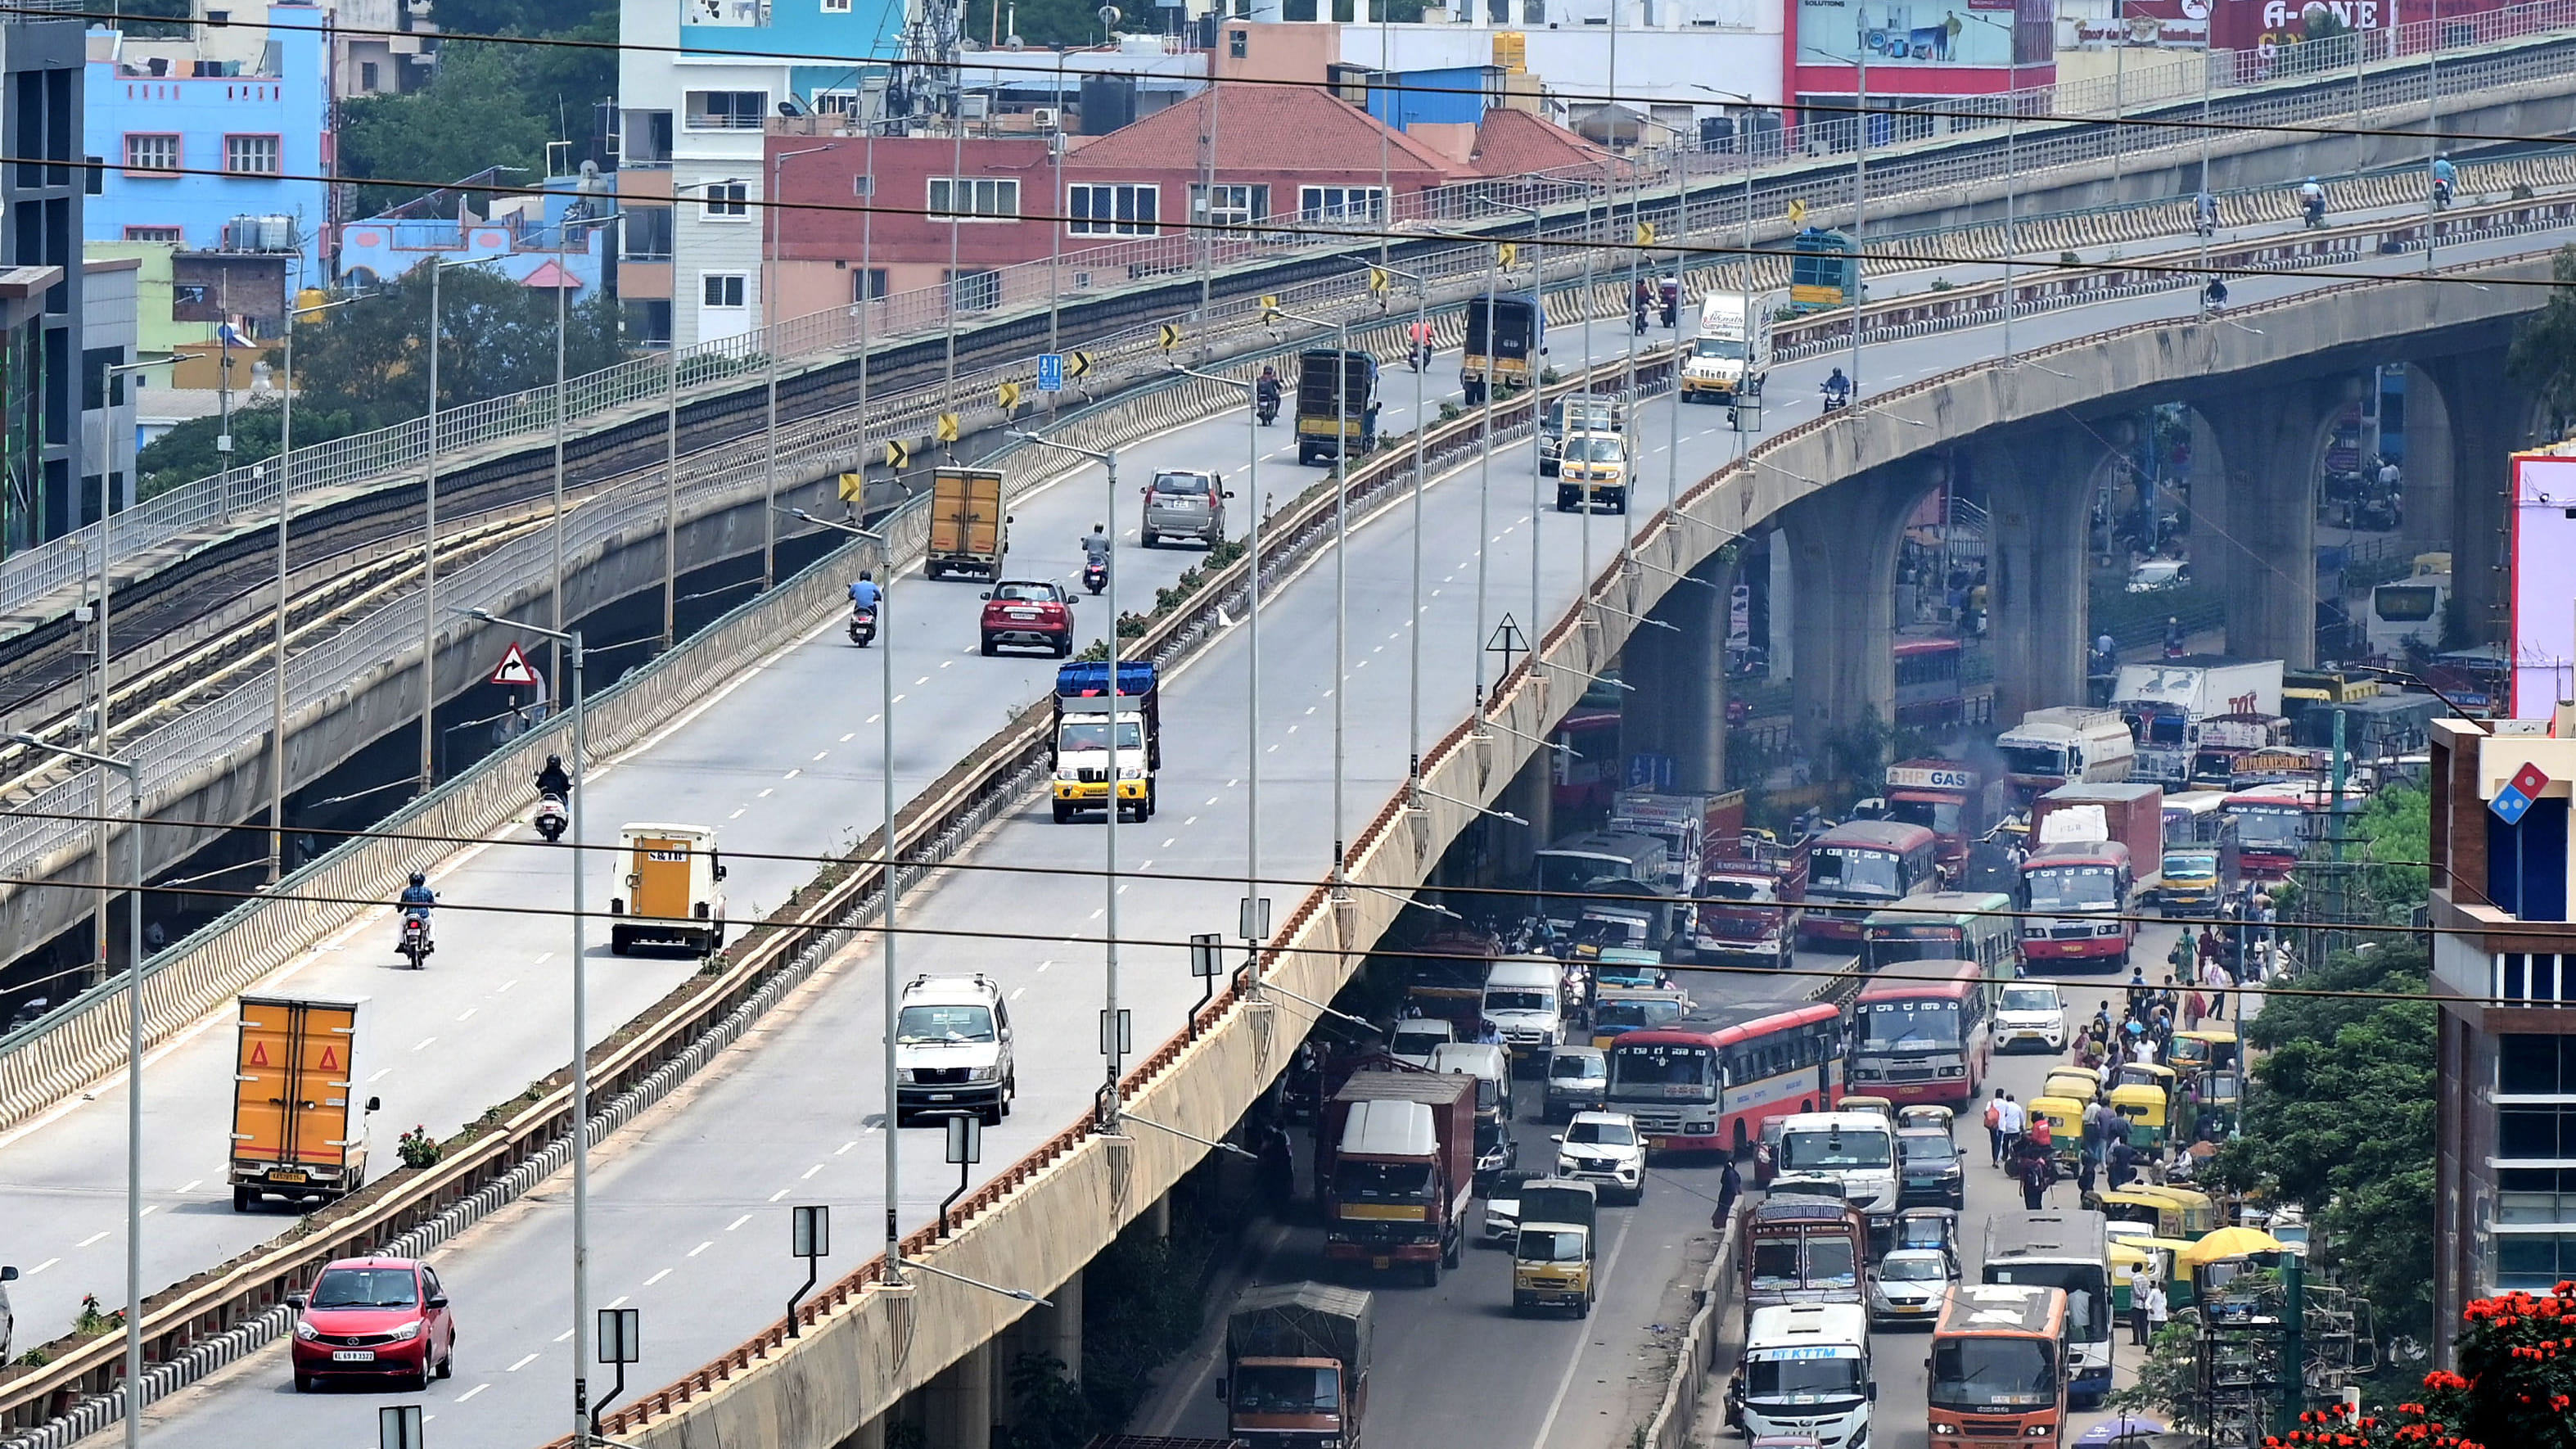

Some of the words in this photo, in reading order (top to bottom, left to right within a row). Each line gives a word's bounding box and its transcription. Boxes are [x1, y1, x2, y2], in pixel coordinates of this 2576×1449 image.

[1902, 770, 1924, 783] HP
[1931, 772, 1966, 786] GAS
[1792, 1347, 1836, 1359] KTTM
